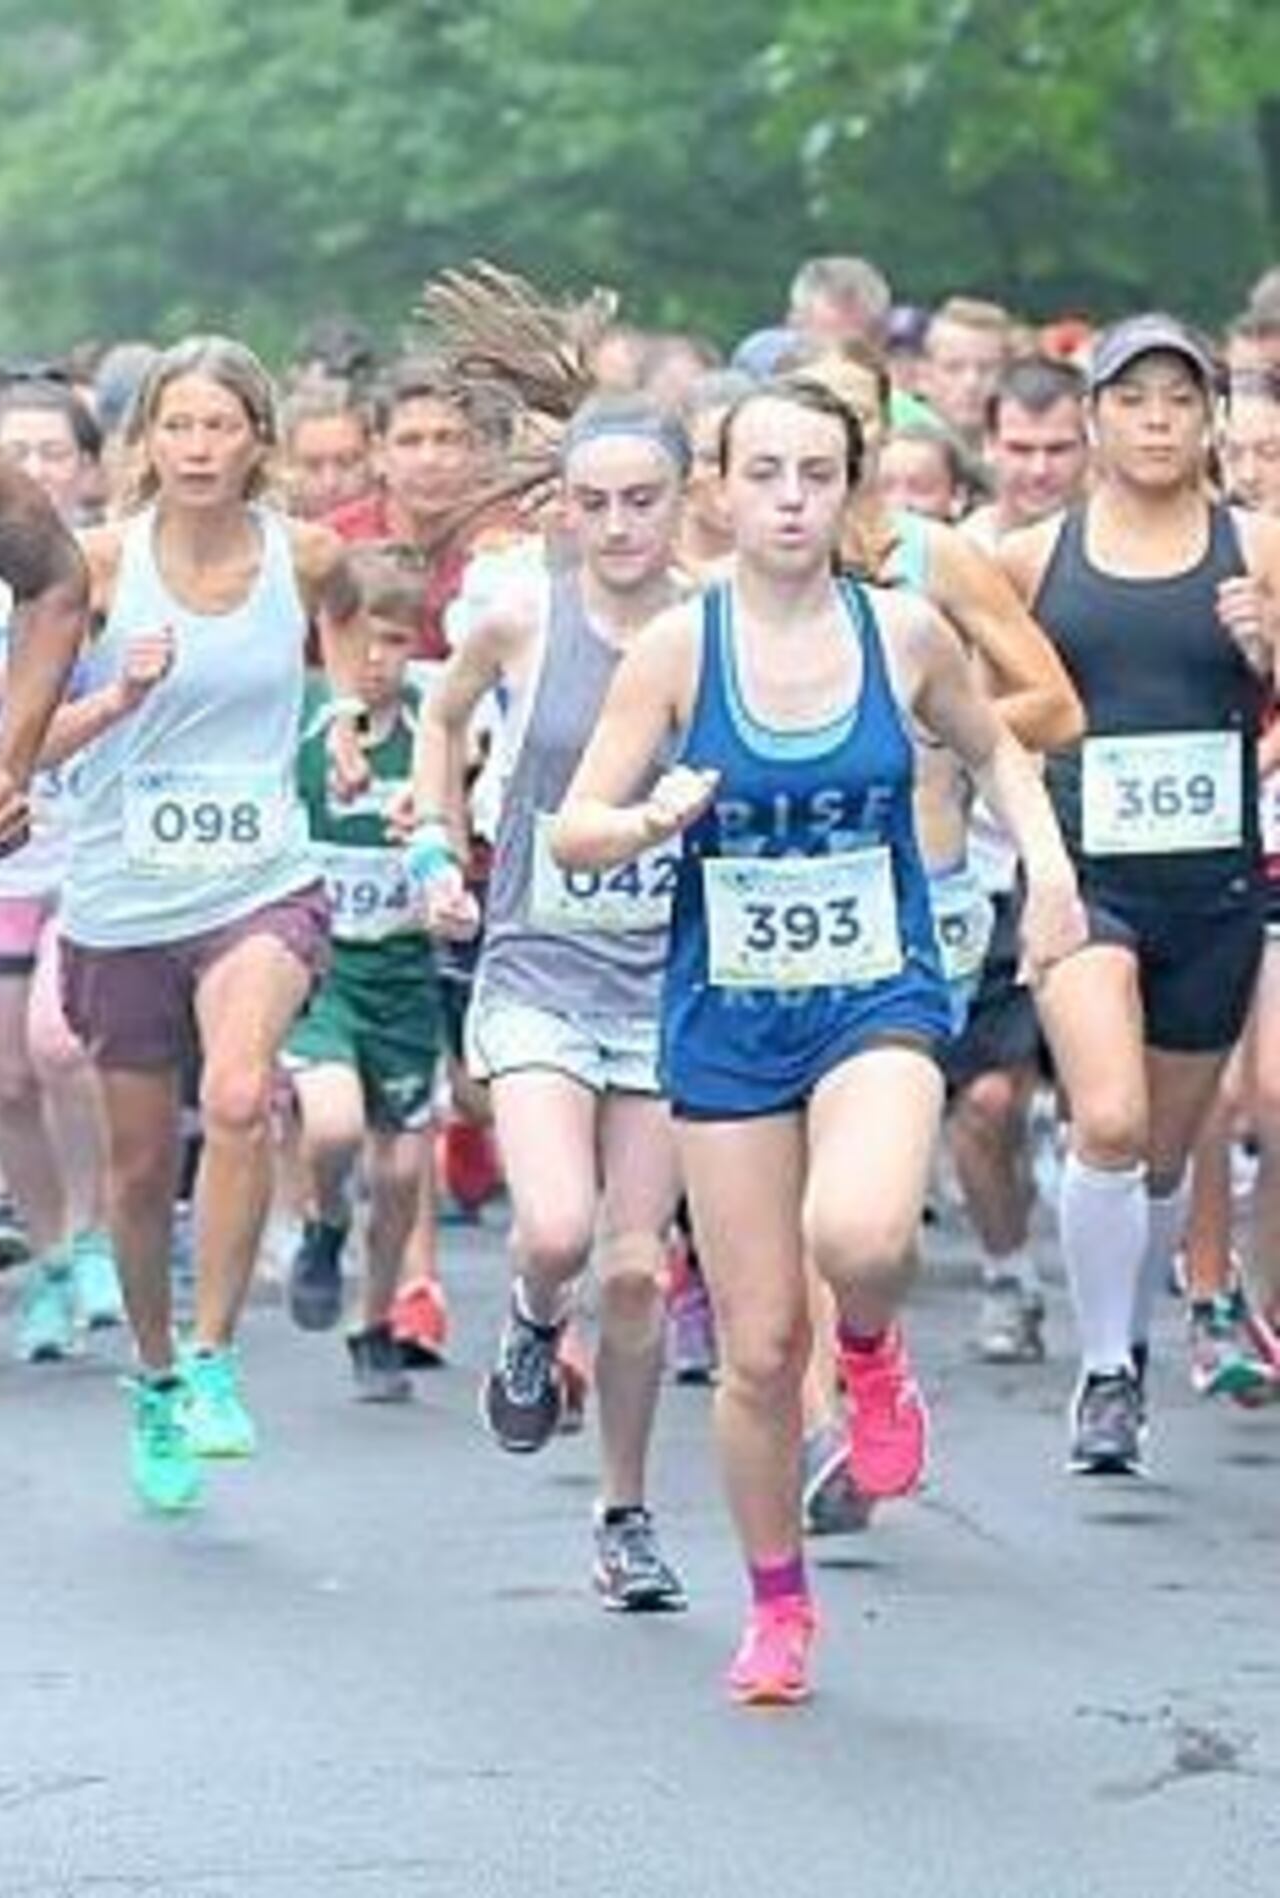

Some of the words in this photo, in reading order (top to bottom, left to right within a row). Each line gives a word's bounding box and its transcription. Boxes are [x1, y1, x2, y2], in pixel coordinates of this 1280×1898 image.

[1114, 774, 1217, 819] 369
[152, 801, 262, 844] 098
[743, 896, 861, 951] 393
